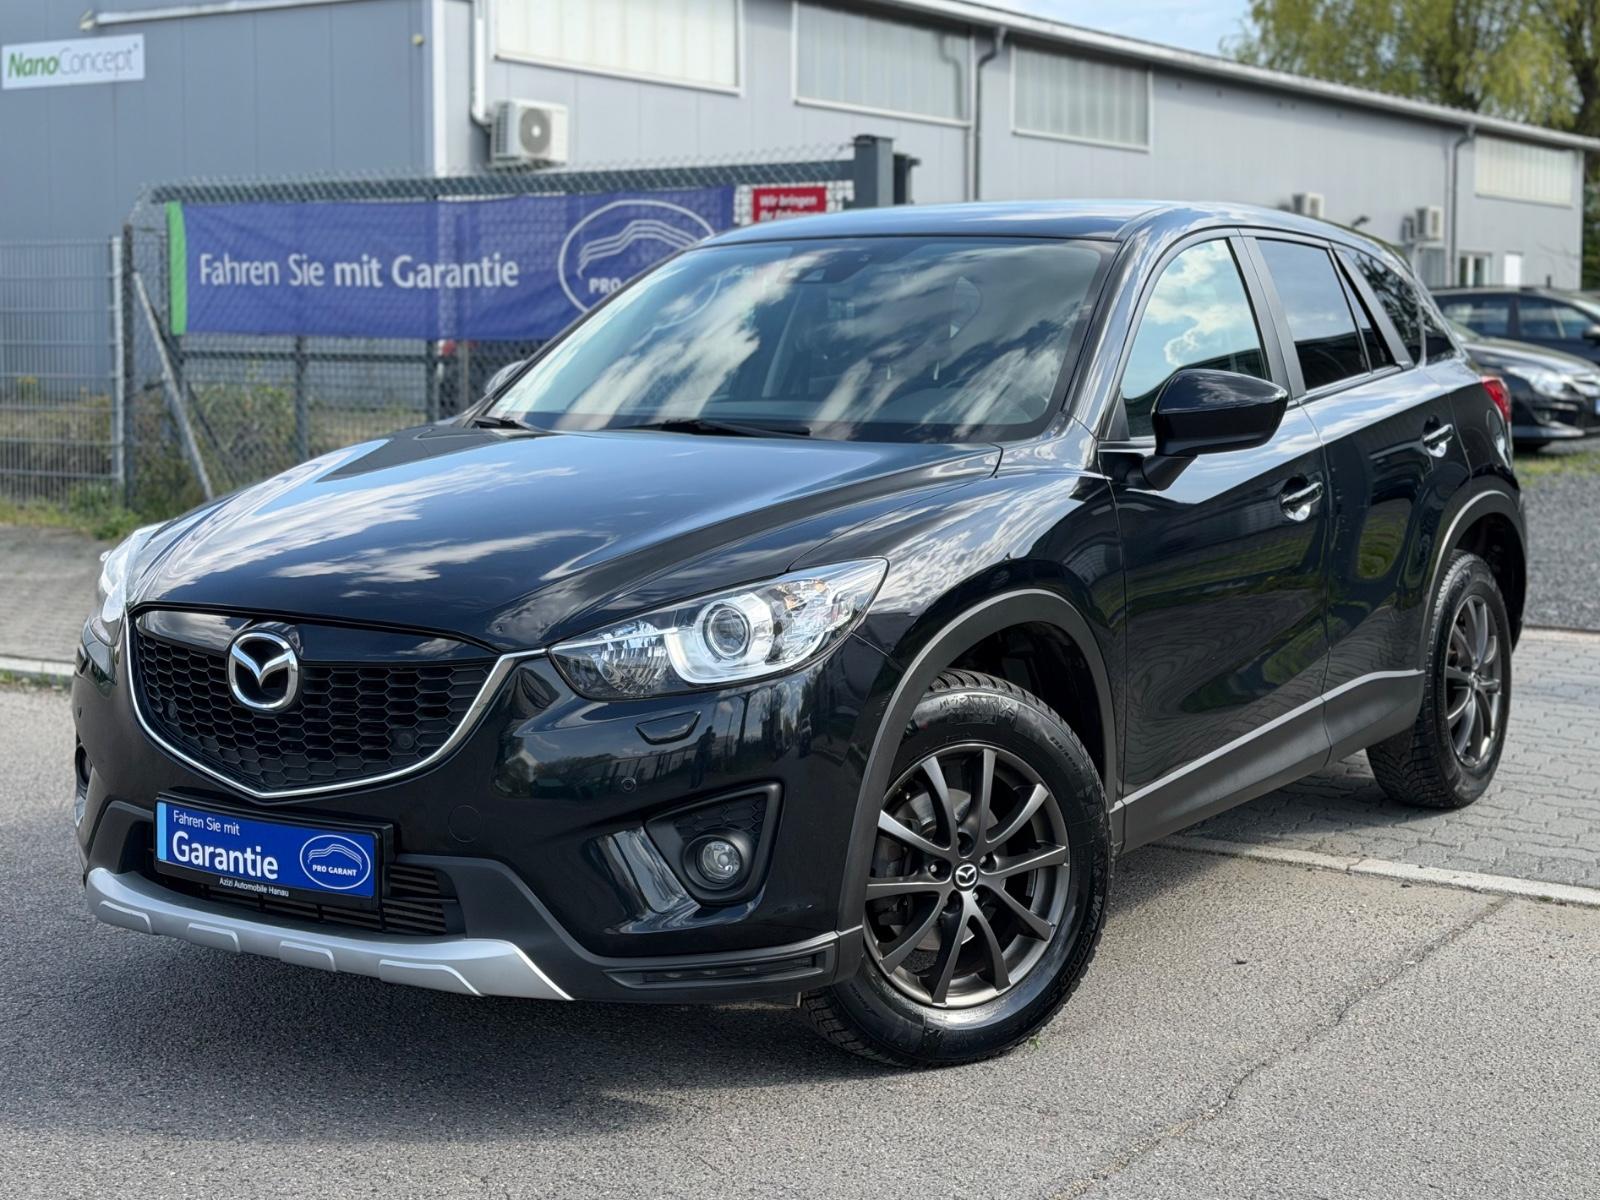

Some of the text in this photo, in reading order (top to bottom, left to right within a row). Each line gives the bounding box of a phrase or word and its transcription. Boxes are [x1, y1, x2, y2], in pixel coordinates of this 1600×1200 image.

[200, 253, 520, 289] Fahren Sie mit Garantie
[589, 277, 622, 294] PRO
[173, 810, 240, 836] Fahren Sie mit
[172, 830, 279, 880] Garantie
[312, 864, 357, 877] PRO GARANT
[219, 877, 290, 897] Azizi Automobile Hanau
